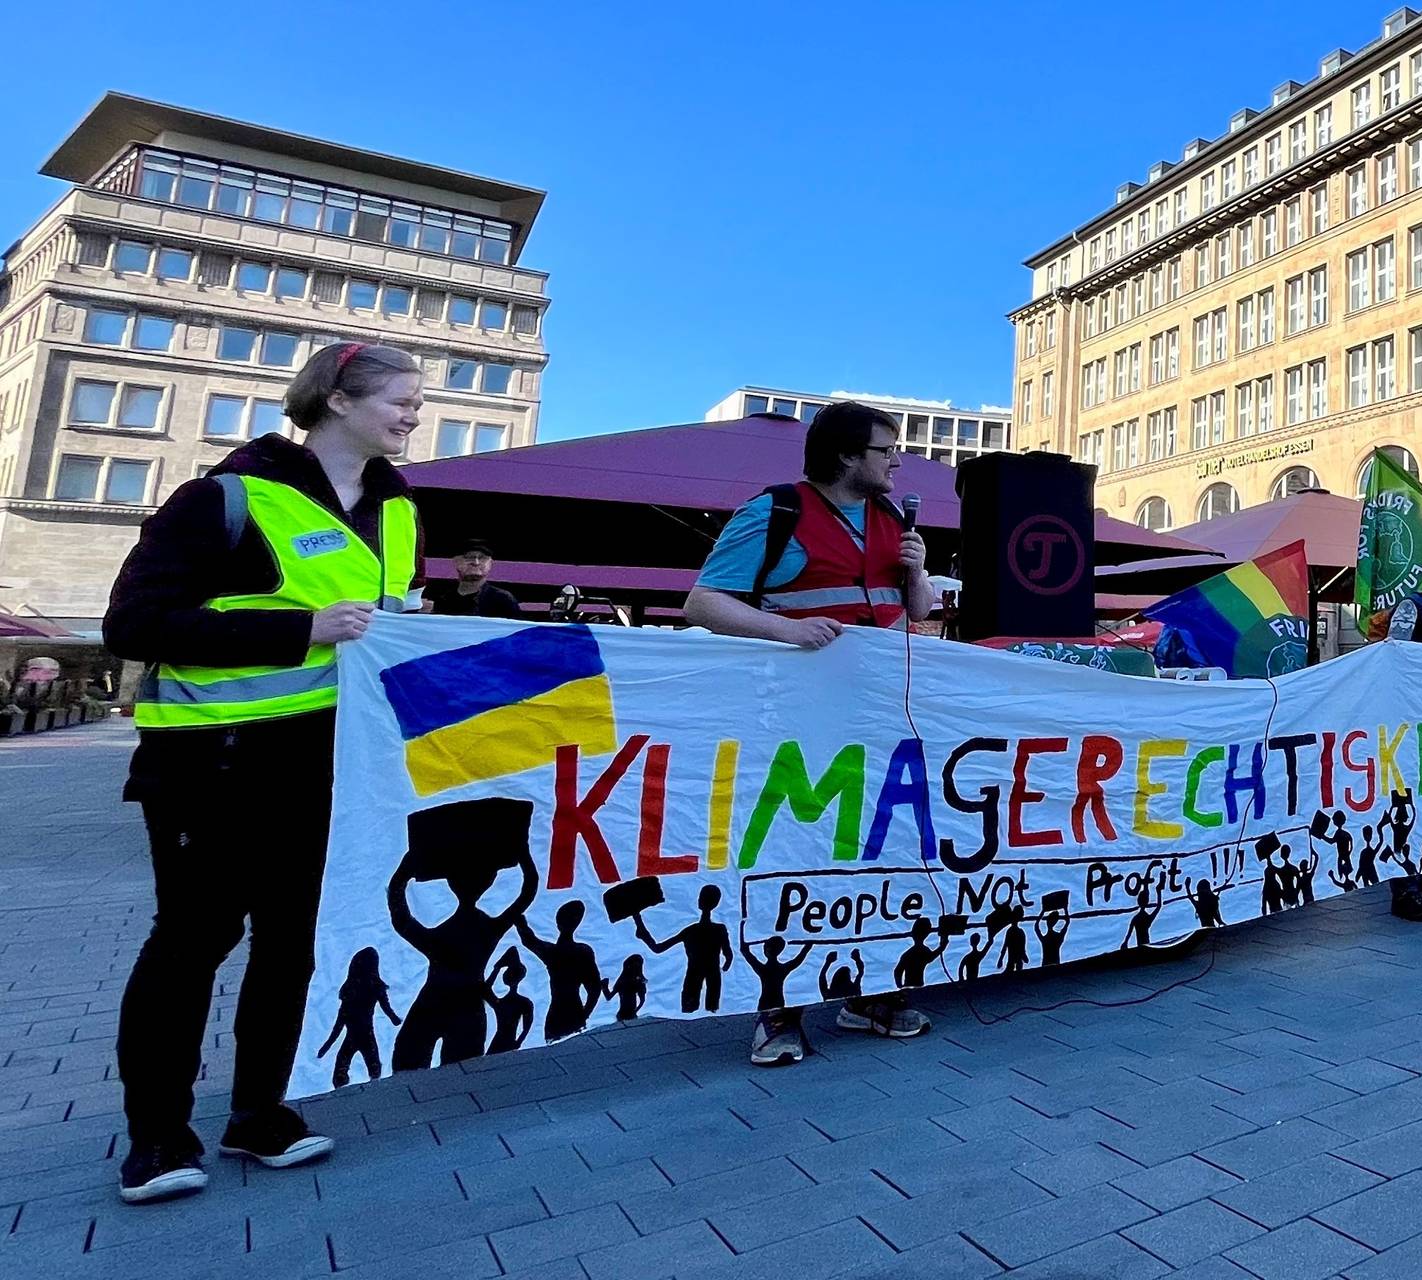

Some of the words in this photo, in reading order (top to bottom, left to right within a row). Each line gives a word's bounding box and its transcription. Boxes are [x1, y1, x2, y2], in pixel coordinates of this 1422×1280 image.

[1268, 618, 1310, 641] FRI
[775, 879, 924, 935] People
[1086, 857, 1182, 906] Profit
